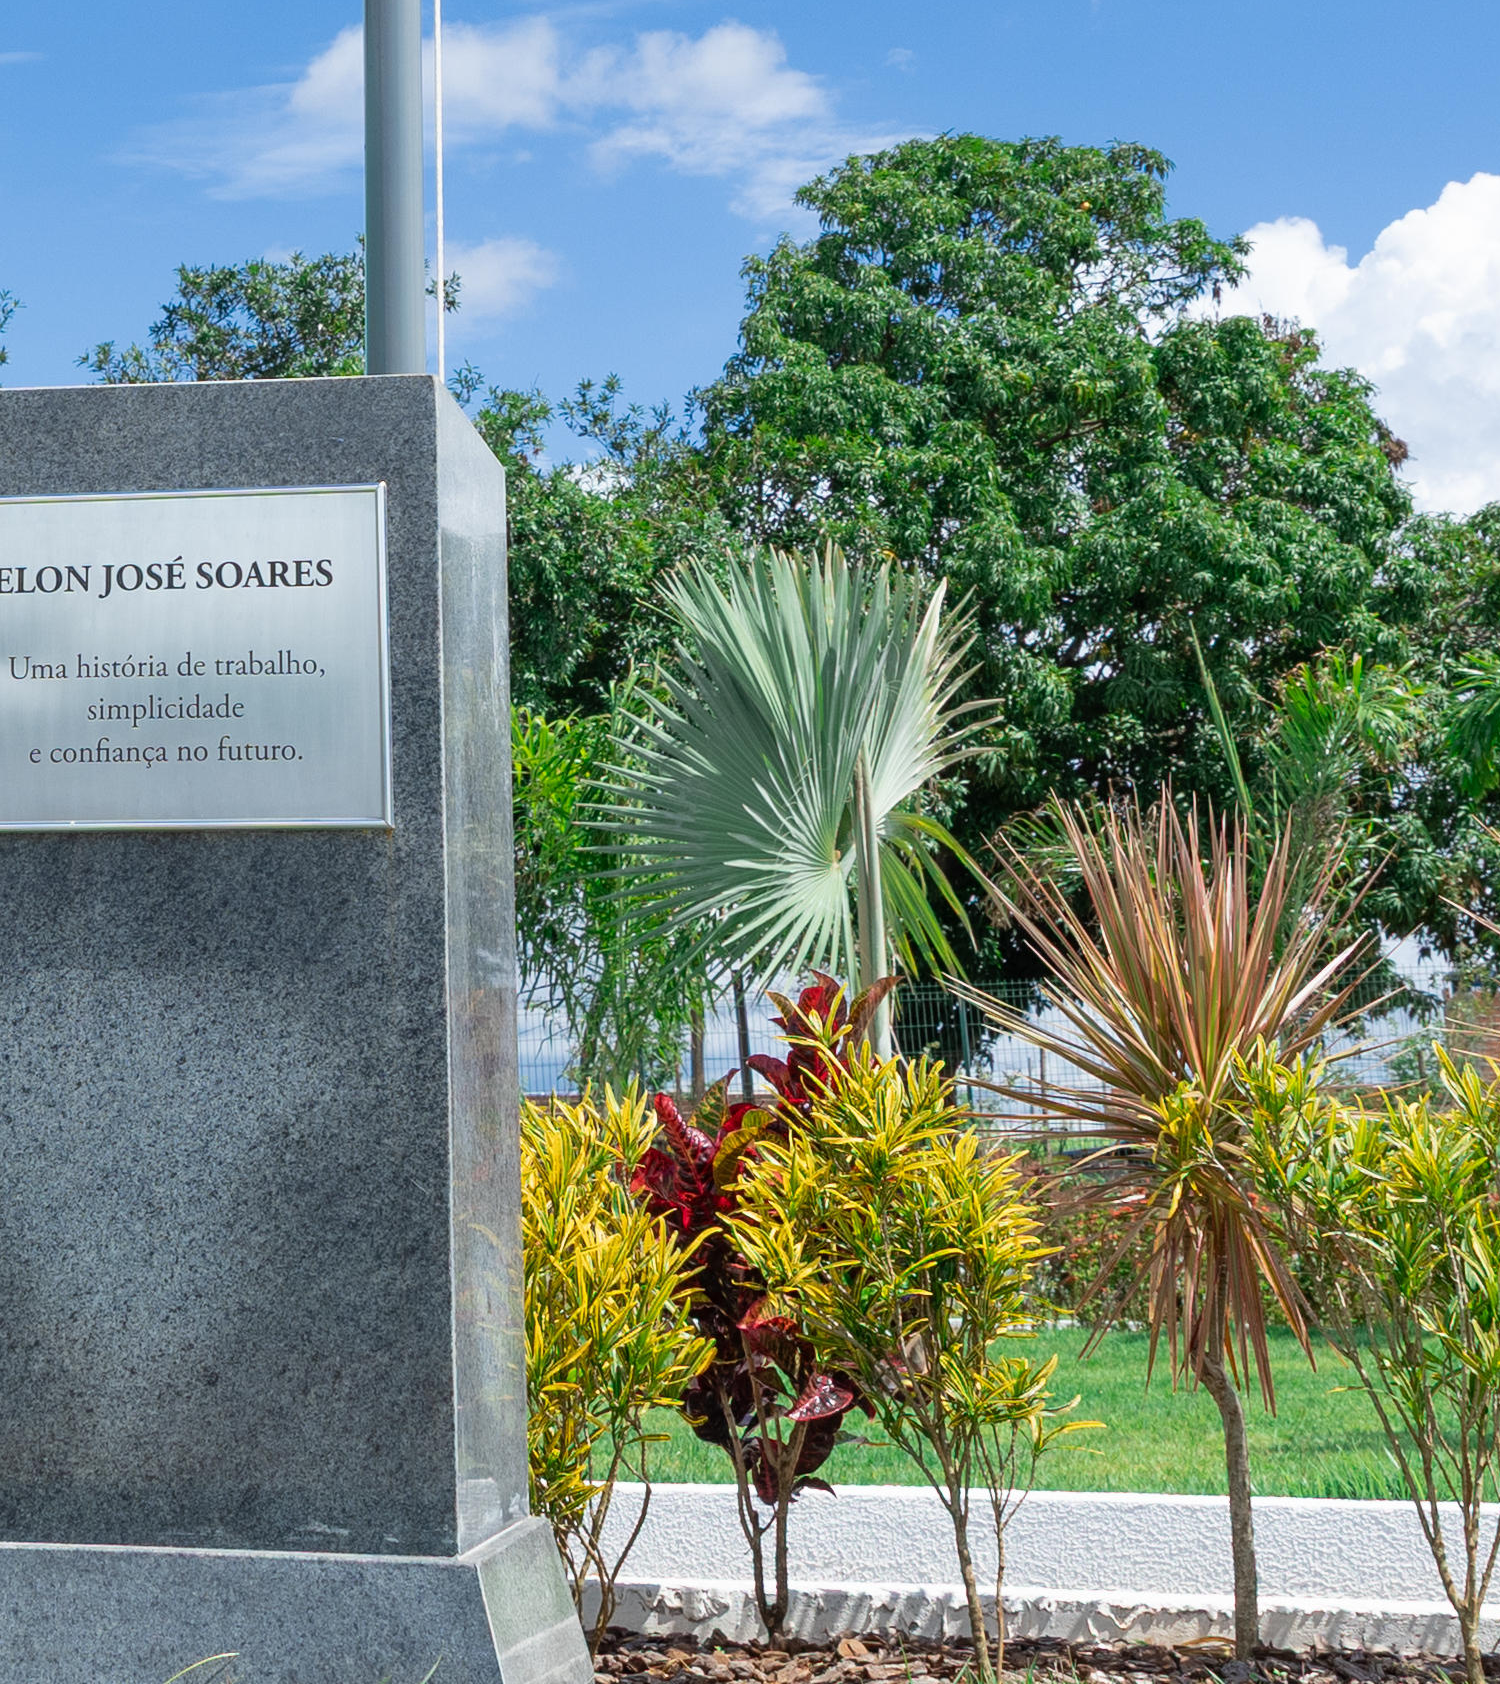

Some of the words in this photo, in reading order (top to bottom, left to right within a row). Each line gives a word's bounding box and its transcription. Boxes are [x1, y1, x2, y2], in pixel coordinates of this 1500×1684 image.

[98, 555, 187, 599] JOSÉ
[195, 559, 333, 590] SOARES
[8, 655, 68, 680] Uma
[76, 653, 169, 679] história
[177, 651, 206, 677] de
[215, 649, 326, 678] trabalho,
[87, 692, 245, 728] simplicidade
[29, 747, 42, 764] e
[50, 737, 169, 769] confiança
[177, 744, 208, 762] no
[217, 735, 304, 761] futuro.
